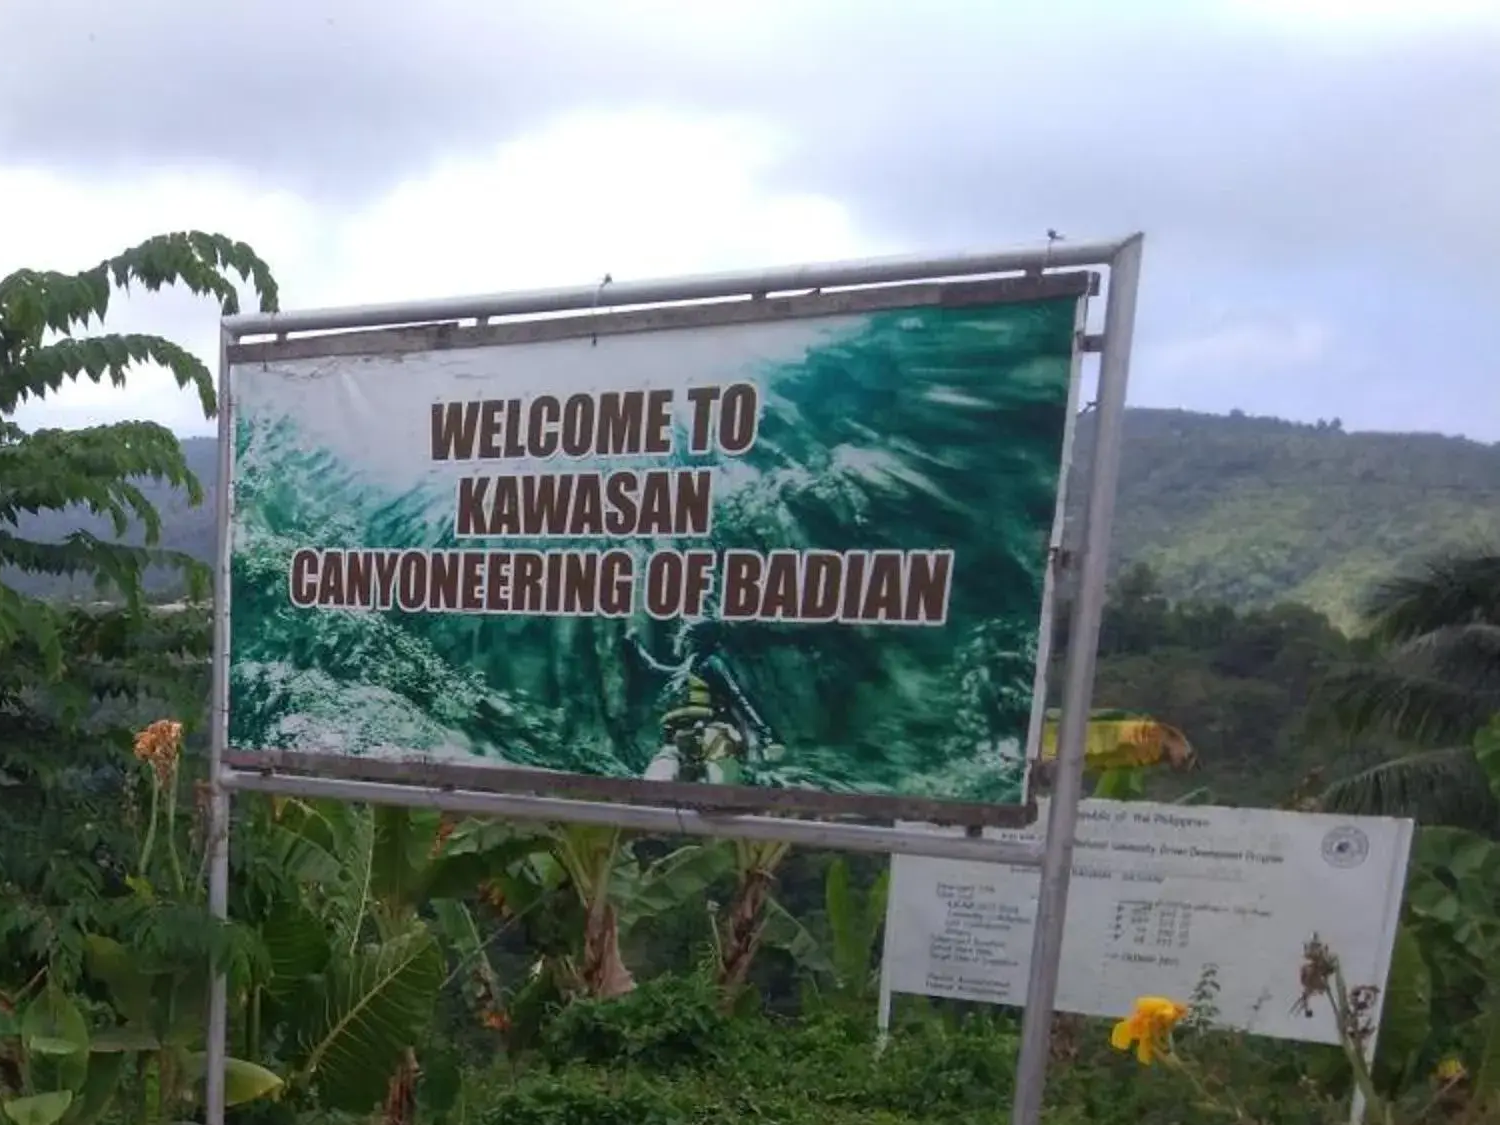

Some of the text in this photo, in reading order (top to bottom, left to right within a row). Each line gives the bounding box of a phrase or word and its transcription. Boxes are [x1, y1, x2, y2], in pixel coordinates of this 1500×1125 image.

[430, 383, 759, 461] WELCOME TO
[455, 471, 712, 537] KAWASAN
[291, 550, 953, 624] CANYONEERING OF BADIAN
